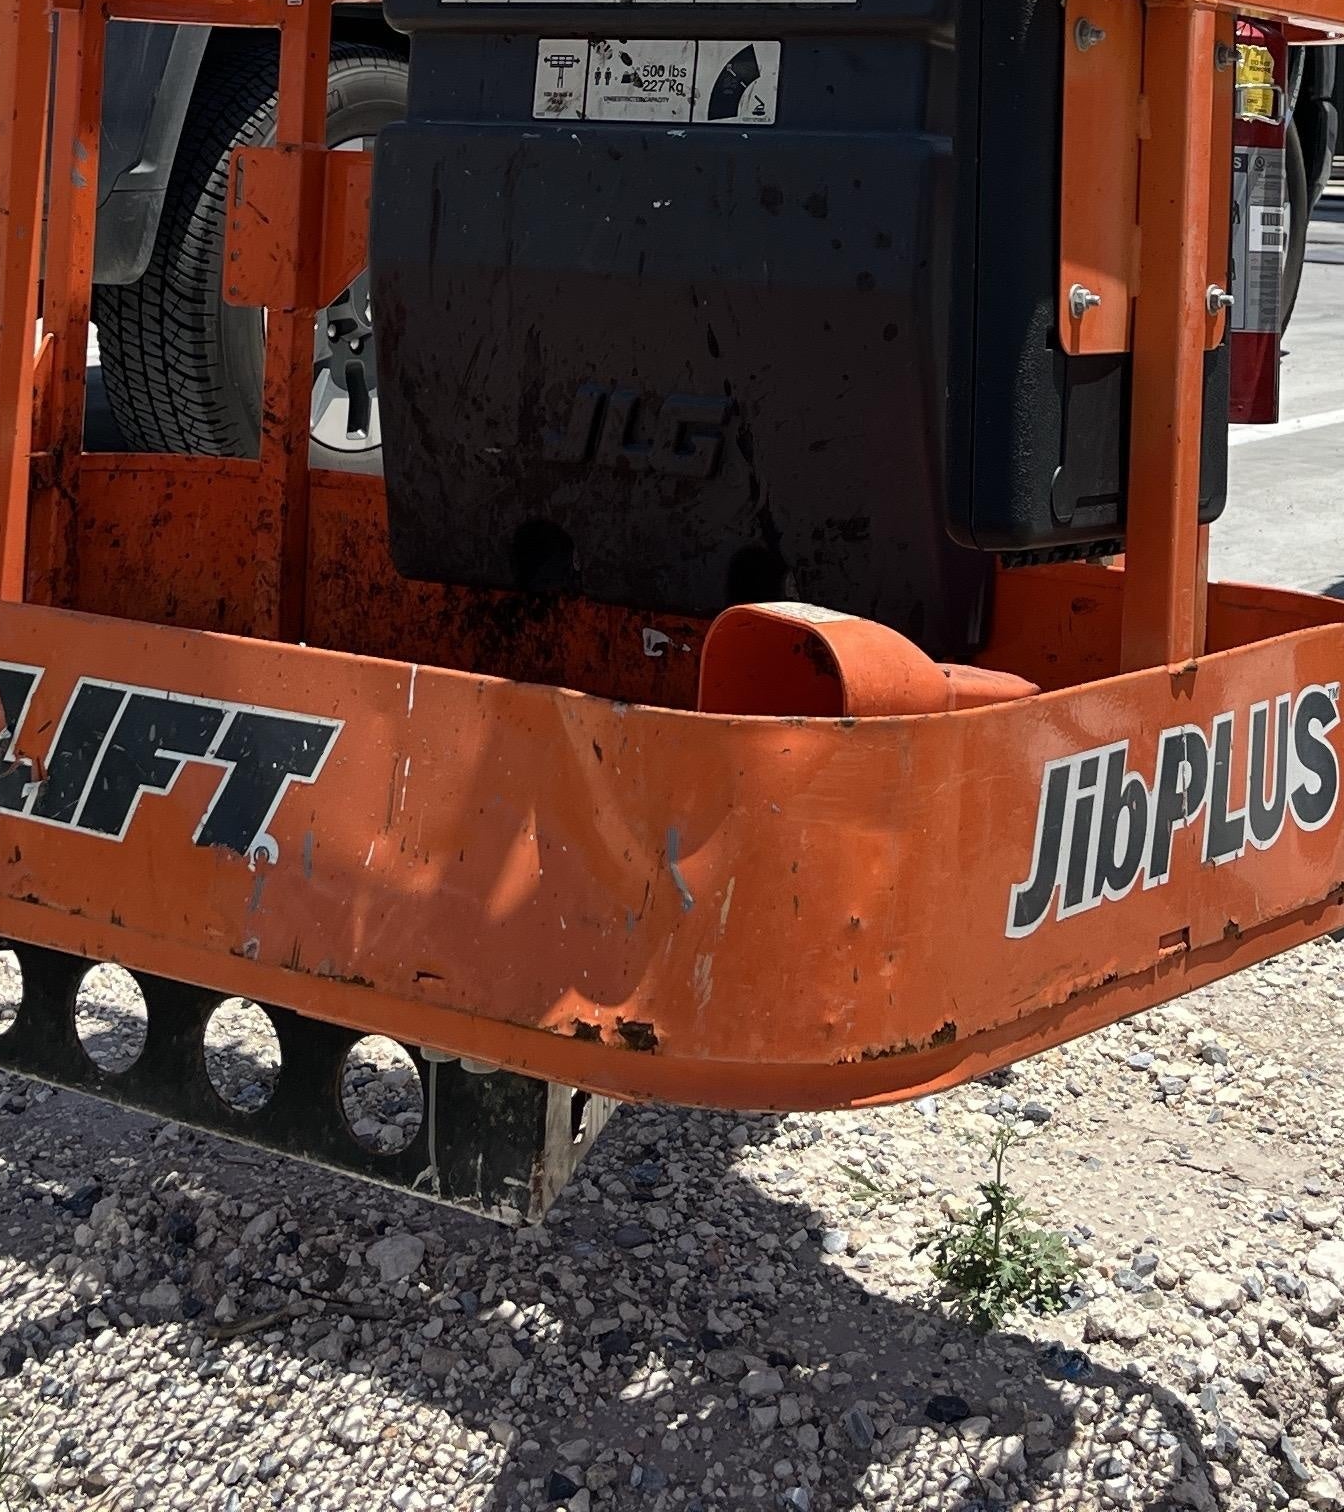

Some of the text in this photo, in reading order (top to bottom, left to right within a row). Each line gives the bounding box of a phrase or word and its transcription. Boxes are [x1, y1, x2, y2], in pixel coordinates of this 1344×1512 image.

[642, 65, 687, 77] 500 lbs
[642, 80, 665, 92] 227
[543, 383, 733, 478] JLG
[1005, 685, 1340, 939] JibPLUS
